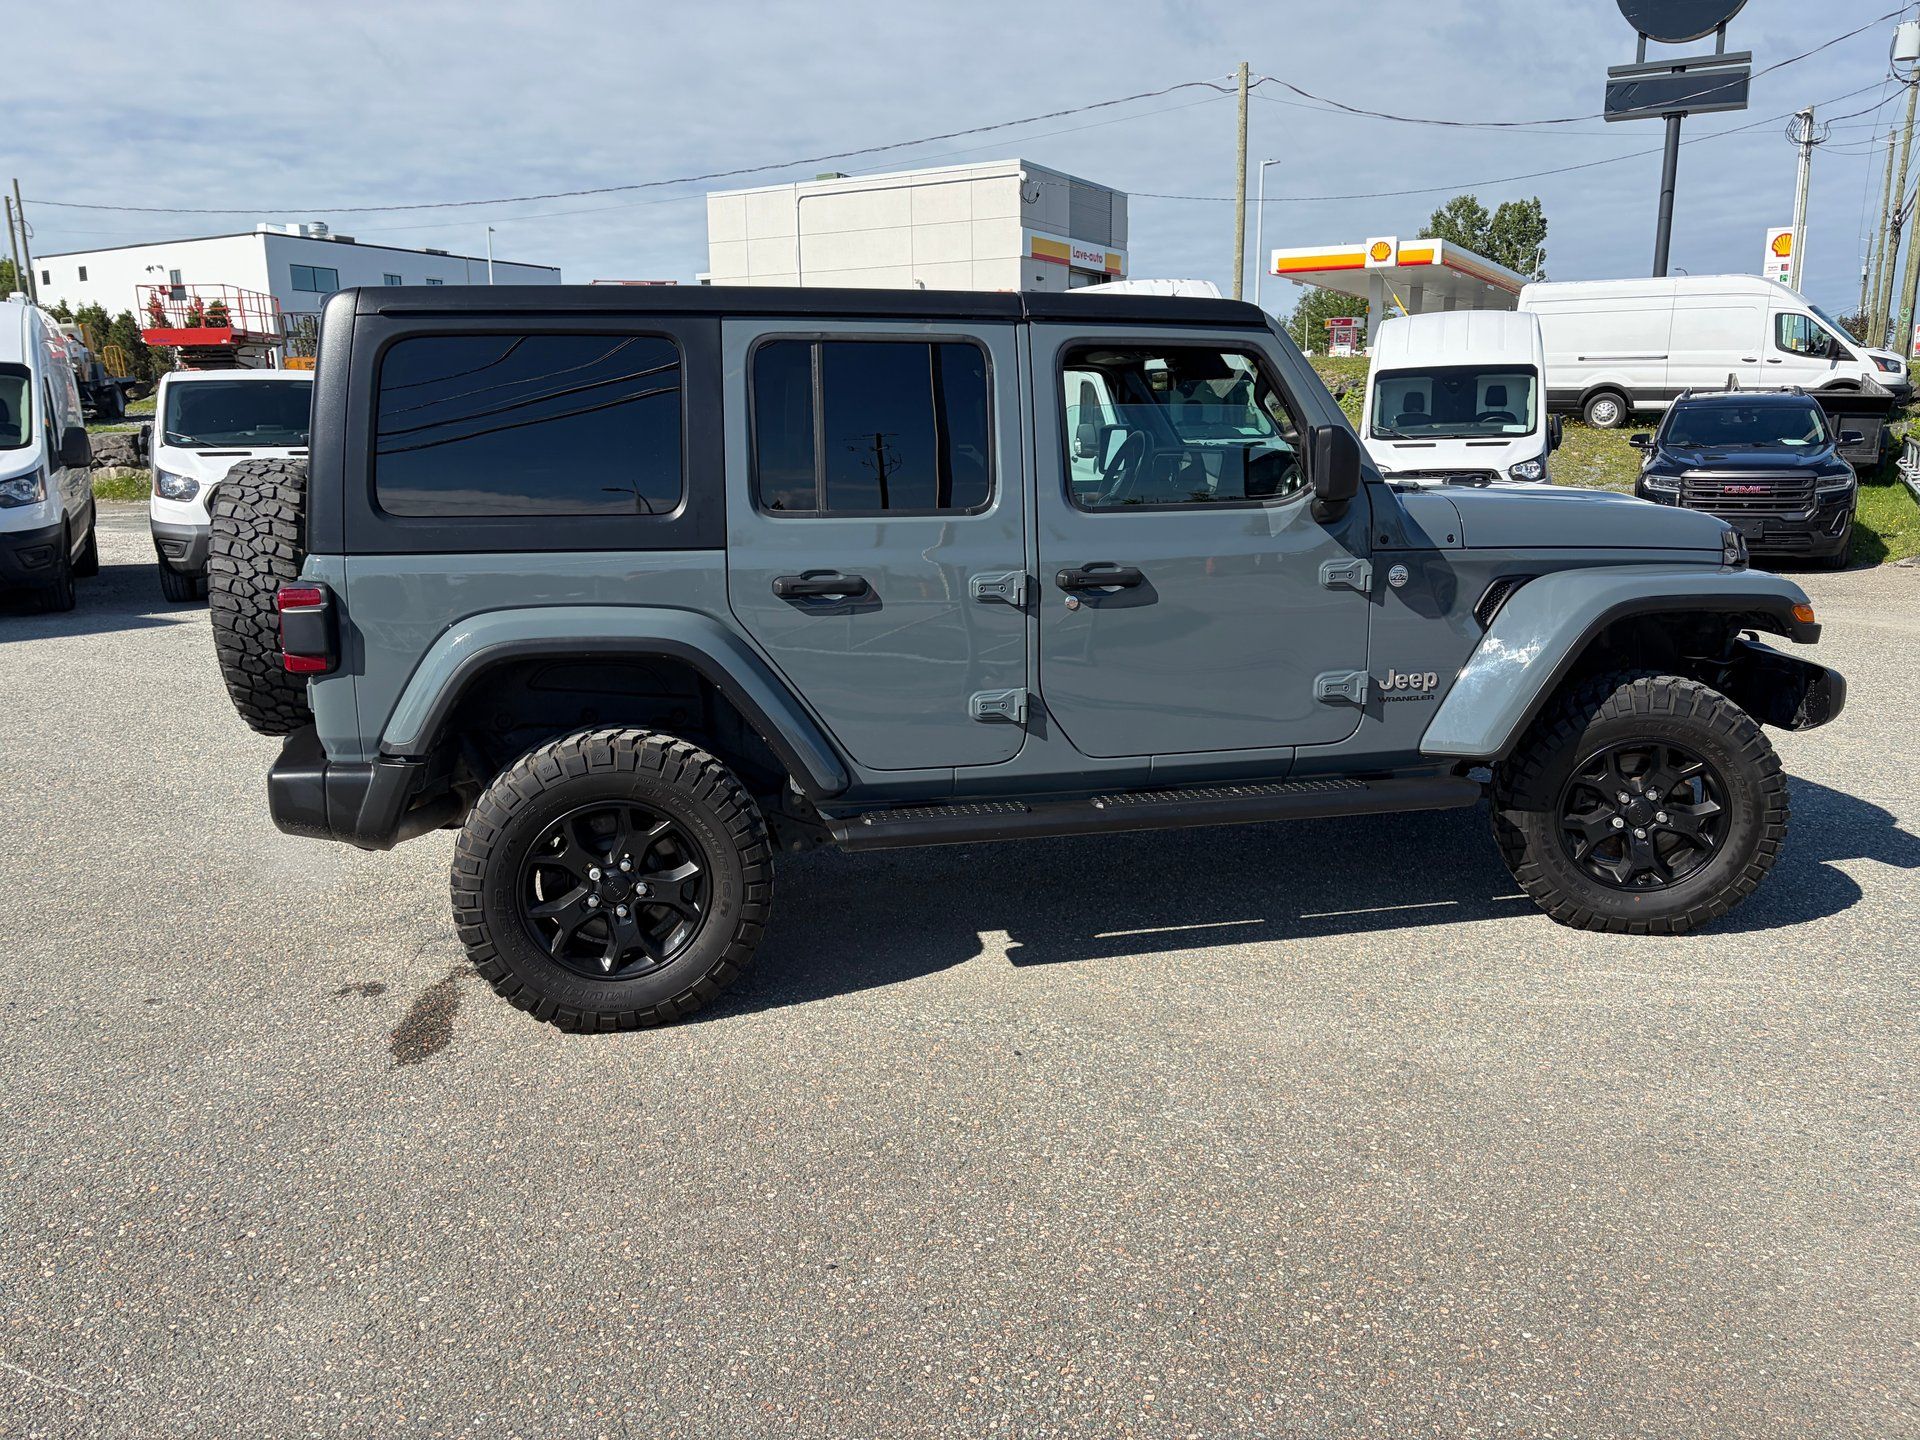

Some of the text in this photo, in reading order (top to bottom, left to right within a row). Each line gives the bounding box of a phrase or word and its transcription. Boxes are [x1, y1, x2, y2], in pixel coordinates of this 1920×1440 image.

[1072, 246, 1103, 264] Lave-auto
[1724, 485, 1771, 494] GMC
[1378, 668, 1438, 692] Jeep
[1377, 694, 1435, 703] WRANGLER
